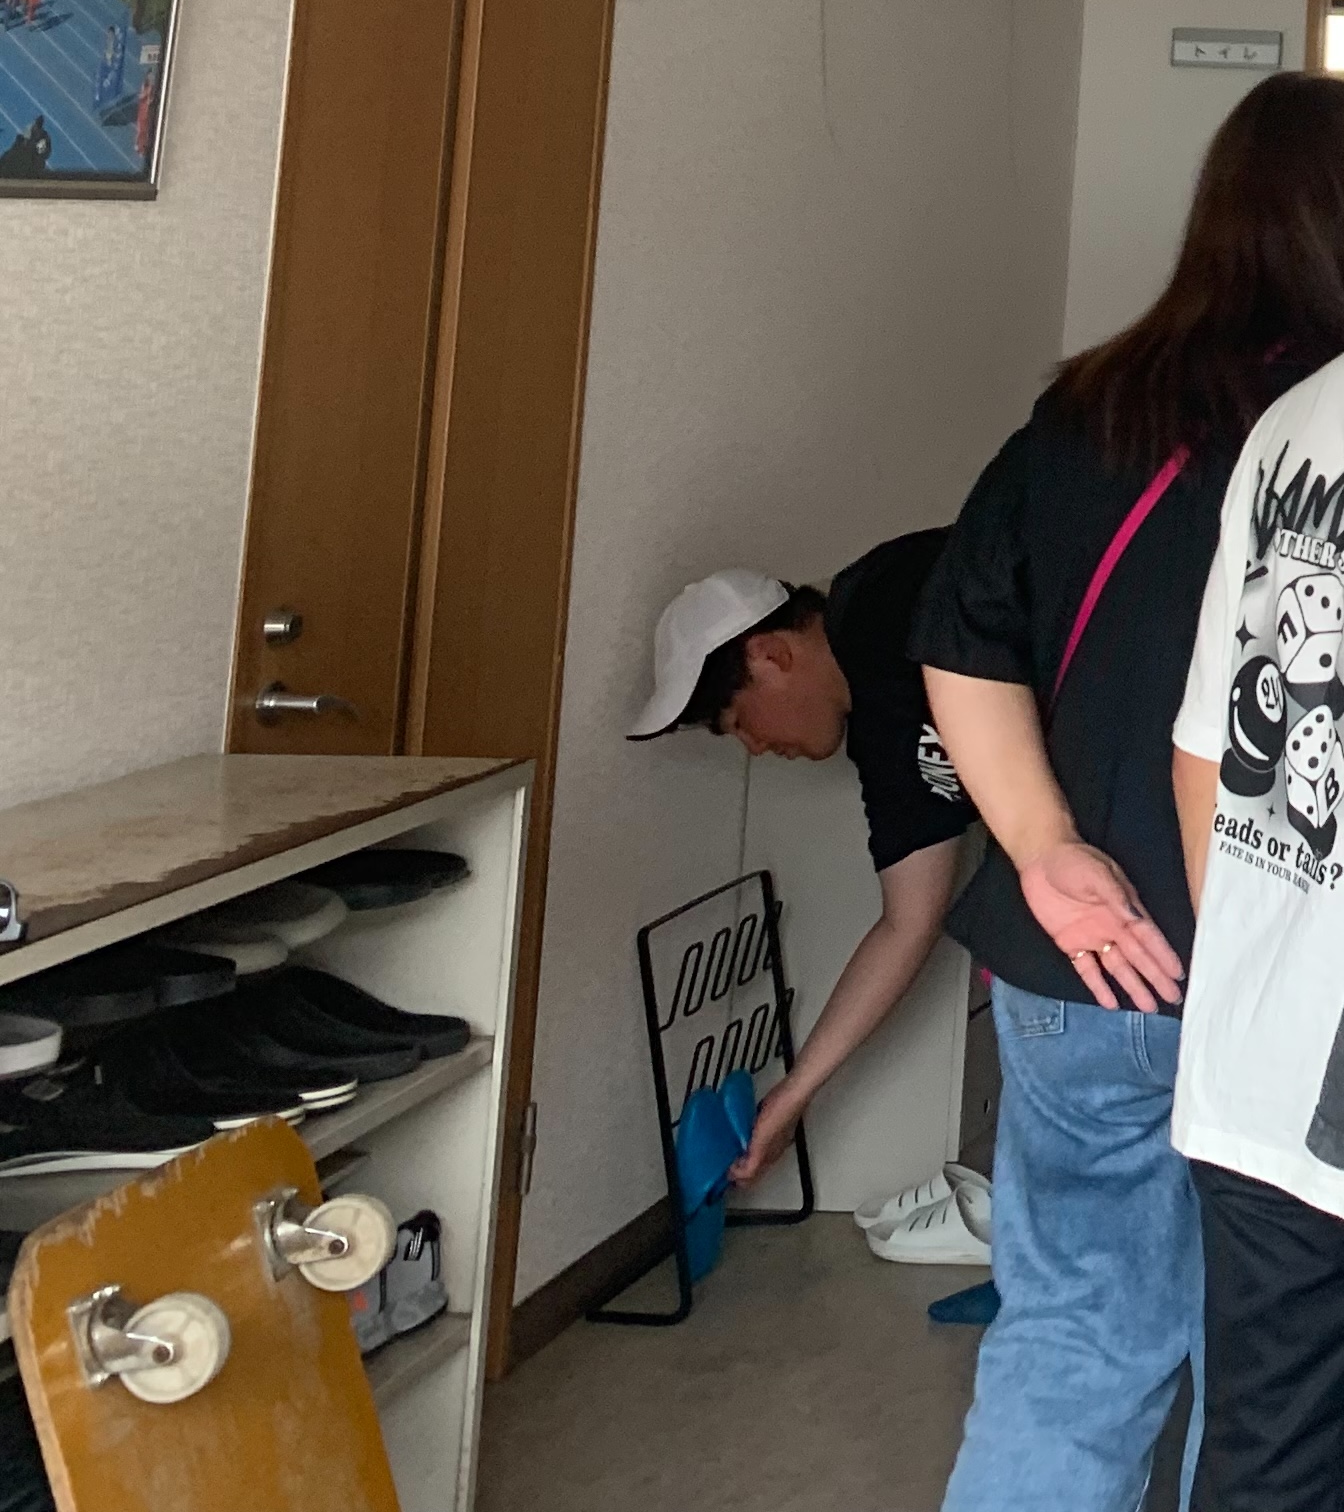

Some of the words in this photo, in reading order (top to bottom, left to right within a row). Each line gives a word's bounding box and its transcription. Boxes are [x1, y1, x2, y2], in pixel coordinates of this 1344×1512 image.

[1194, 46, 1257, 59] トイレ
[1219, 840, 1244, 860] FATE
[1244, 851, 1255, 865] IS
[1255, 856, 1267, 870] IN
[1267, 861, 1292, 882] YOUR
[1267, 835, 1291, 862] or
